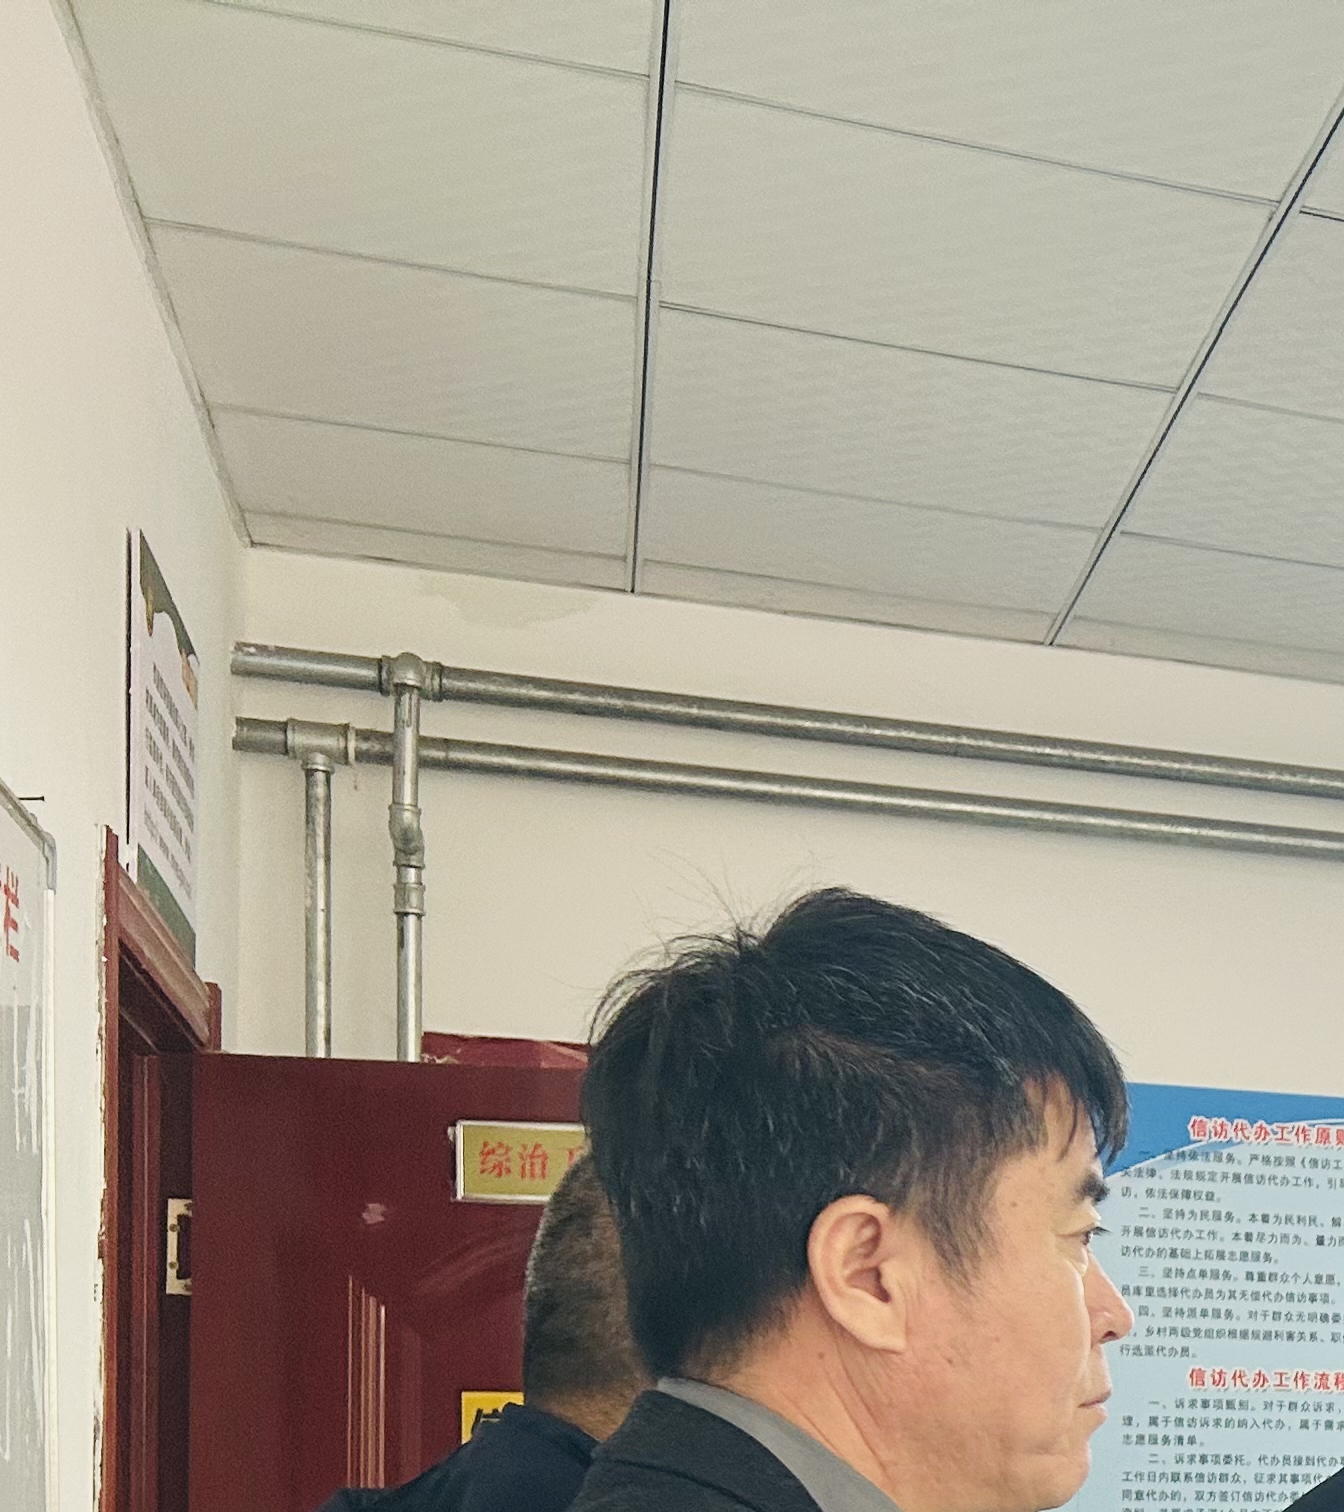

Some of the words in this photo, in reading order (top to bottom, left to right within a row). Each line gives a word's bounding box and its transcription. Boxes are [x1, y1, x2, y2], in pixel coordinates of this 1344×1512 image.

[1122, 1433, 1204, 1446] 志愿服务清单。
[1122, 1471, 1327, 1484] 工作日内联系信访群众，征求其事项代
